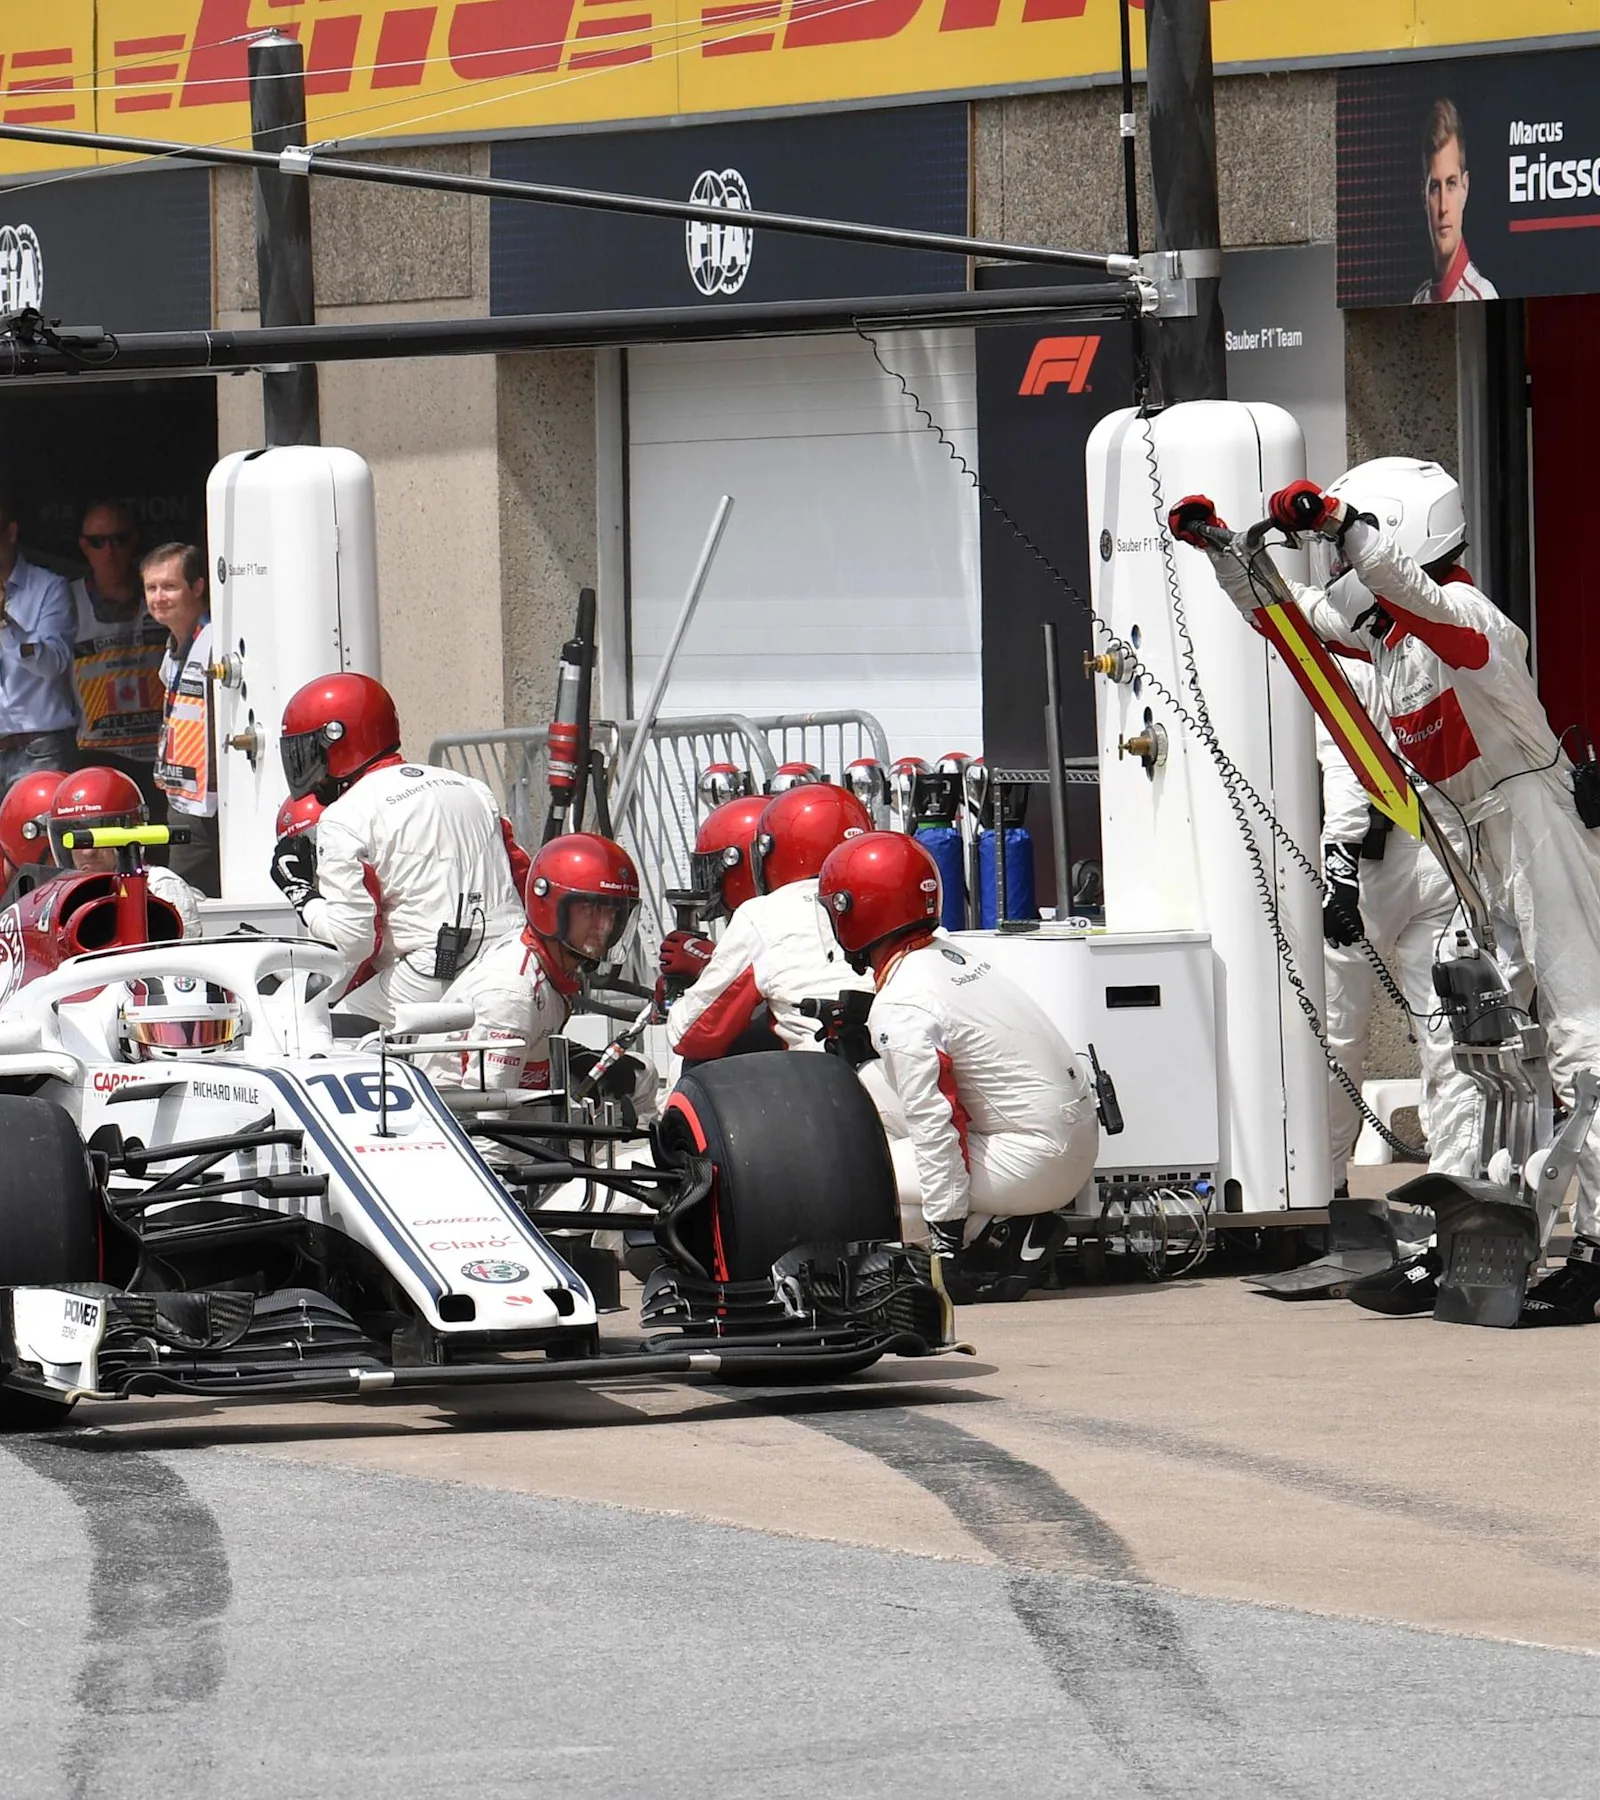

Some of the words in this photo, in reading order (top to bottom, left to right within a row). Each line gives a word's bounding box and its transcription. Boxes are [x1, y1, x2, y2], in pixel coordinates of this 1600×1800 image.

[1509, 121, 1563, 145] Marcus
[1225, 330, 1260, 351] Sauber
[1276, 328, 1303, 348] Team
[1117, 537, 1142, 552] Sauber
[385, 782, 427, 806] Sauber
[193, 1081, 231, 1101] RICHARD
[233, 1087, 259, 1105] MILLE
[305, 1072, 415, 1115] 16
[412, 1216, 502, 1226] CARRERA
[429, 1238, 509, 1251] Claro
[64, 1298, 98, 1328] POWER
